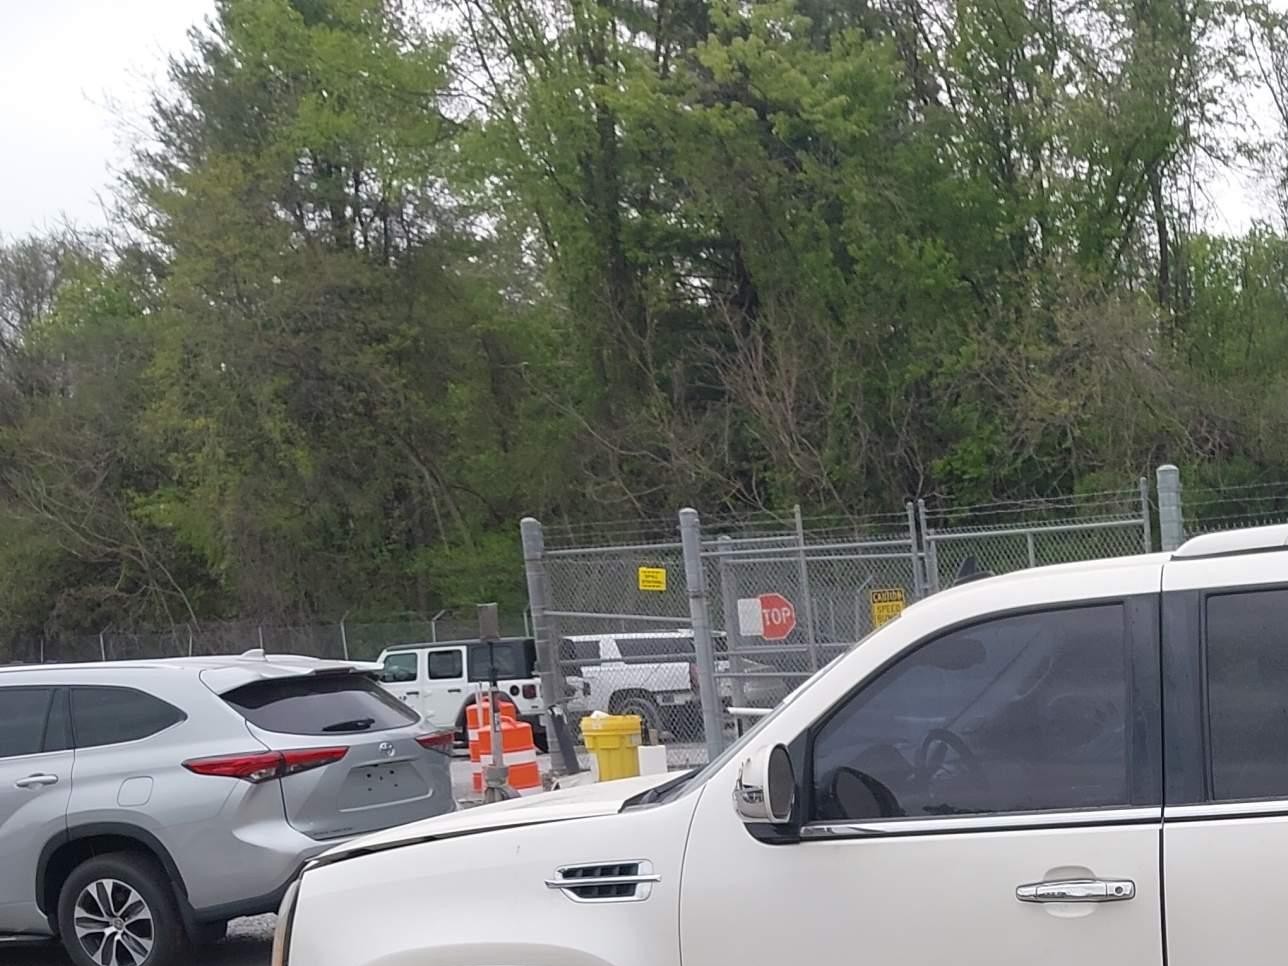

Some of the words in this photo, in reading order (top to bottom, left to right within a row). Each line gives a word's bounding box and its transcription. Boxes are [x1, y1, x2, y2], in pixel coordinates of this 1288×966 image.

[872, 591, 903, 603] CAUTION
[877, 604, 901, 615] SPEED
[762, 607, 791, 625] TOP
